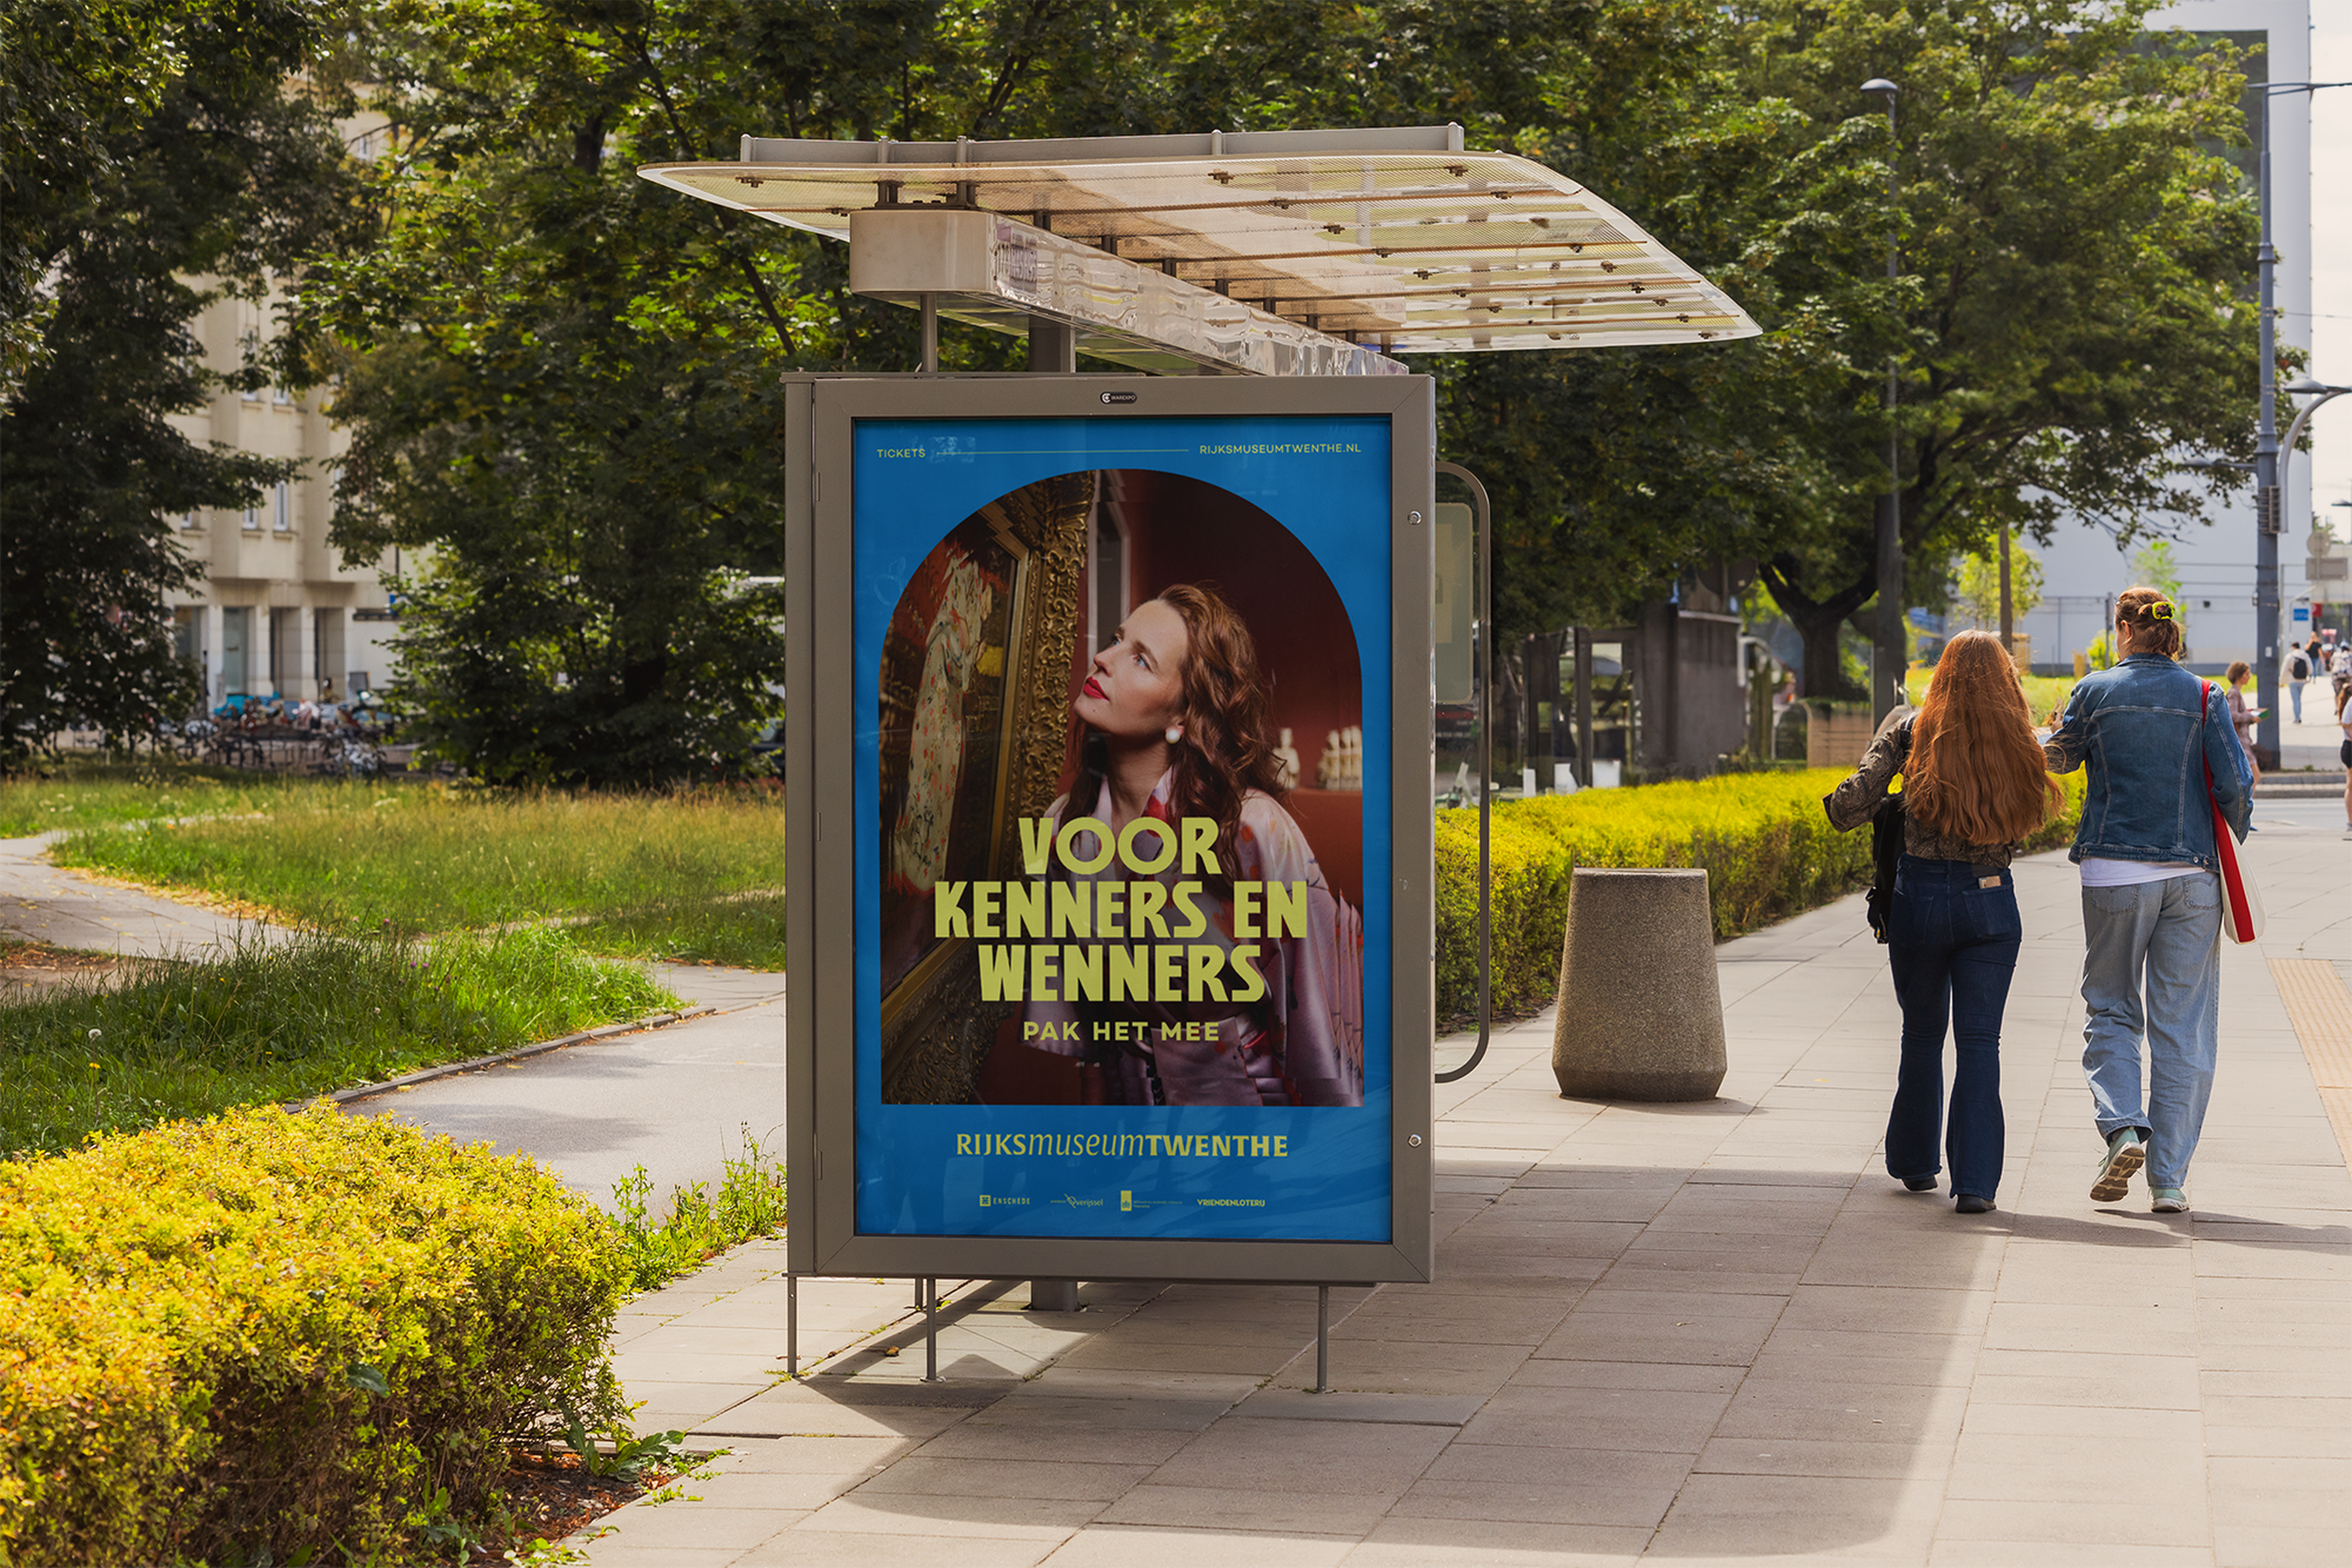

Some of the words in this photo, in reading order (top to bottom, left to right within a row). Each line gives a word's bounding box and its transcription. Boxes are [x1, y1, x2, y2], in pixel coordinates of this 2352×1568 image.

[876, 448, 926, 459] TICKETS
[1200, 443, 1362, 455] RIJKSMUSEUMTWENTHE.NL
[1018, 816, 1222, 875] VOOR
[934, 881, 1207, 938] KENNERS
[1233, 881, 1307, 938] EN
[978, 944, 1265, 1002] WENNERS
[1023, 1021, 1081, 1041] PAK
[1093, 1022, 1149, 1041] HET
[1161, 1022, 1219, 1041] MEE
[956, 1133, 1288, 1157] RIJKSmuseumTWENTHE
[993, 1197, 1031, 1205] ENSCHEDE
[1197, 1198, 1266, 1207] VRIENDENLOTERIJ
